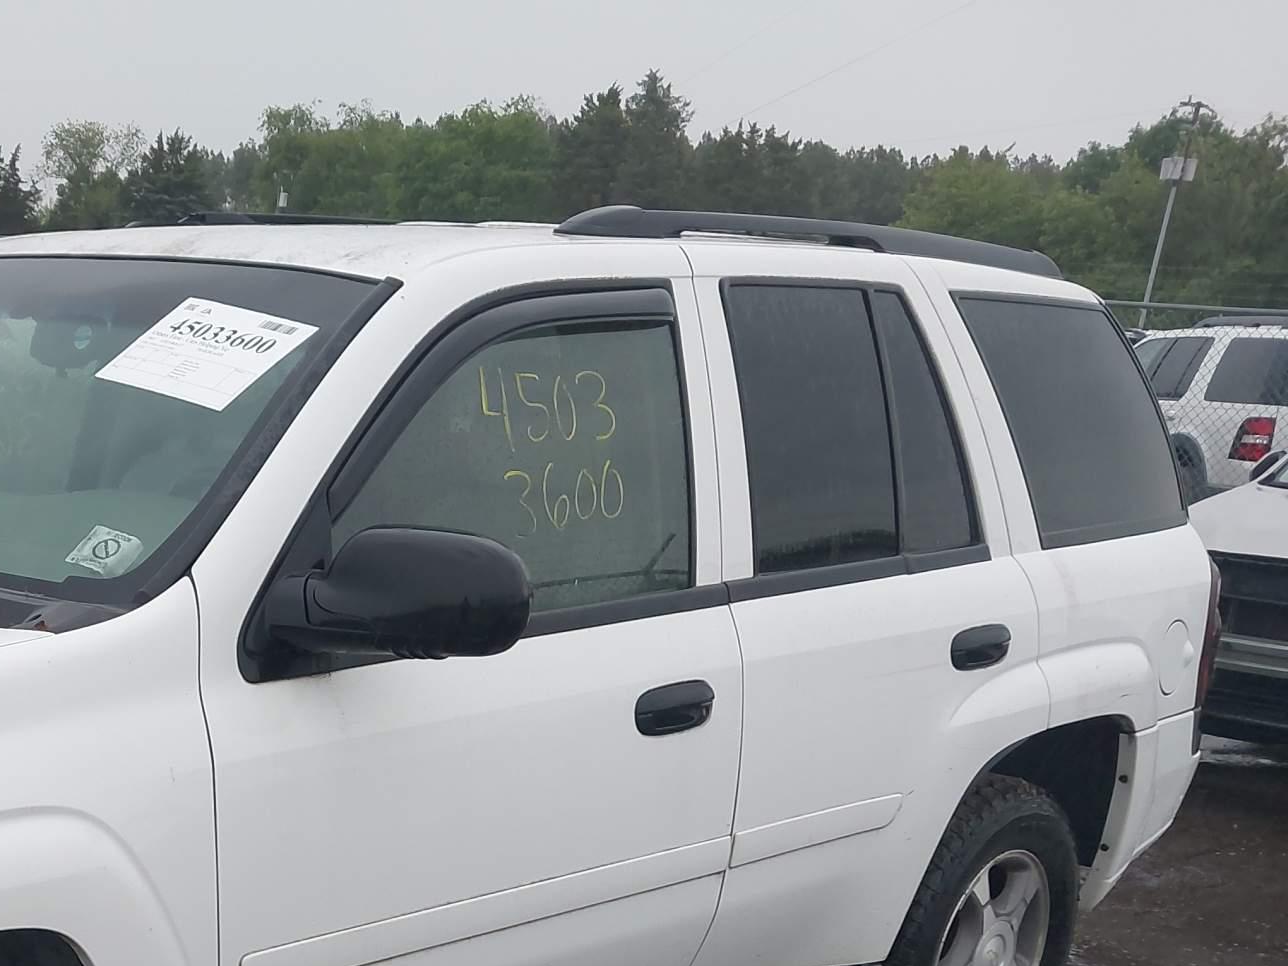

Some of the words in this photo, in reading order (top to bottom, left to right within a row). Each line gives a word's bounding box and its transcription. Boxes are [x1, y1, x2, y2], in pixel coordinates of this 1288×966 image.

[170, 319, 277, 354] 45033600
[479, 366, 616, 452] 4503
[503, 459, 624, 538] 3600
